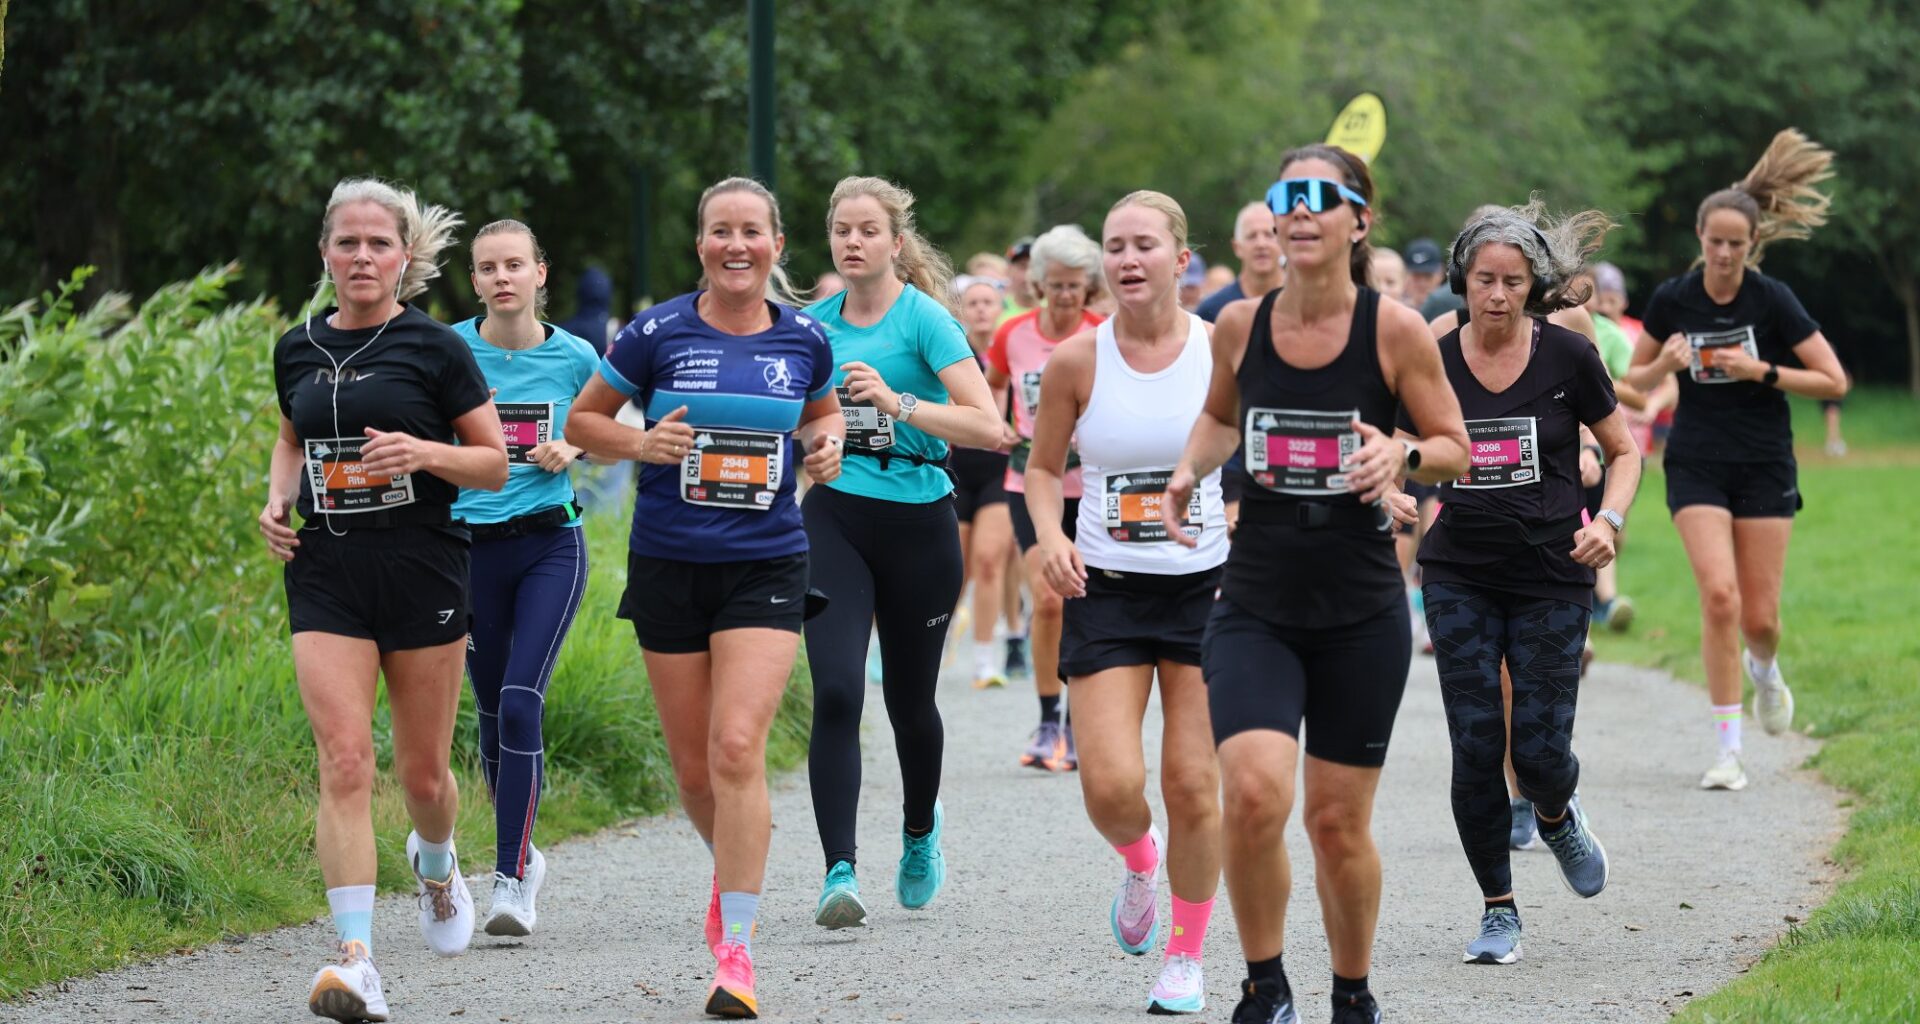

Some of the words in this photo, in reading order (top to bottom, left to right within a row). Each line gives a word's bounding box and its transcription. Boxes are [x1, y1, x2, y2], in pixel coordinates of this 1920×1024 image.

[502, 424, 518, 432] 217
[1288, 439, 1316, 452] 3222
[1477, 443, 1501, 453] 3098
[1471, 455, 1508, 465] Margunn
[343, 464, 365, 475] 295
[719, 469, 751, 481] Marita
[1513, 471, 1531, 479] DNO
[347, 476, 366, 485] Rita
[384, 492, 404, 501] DNO
[1141, 496, 1161, 507] 294
[1144, 508, 1161, 518] Sin
